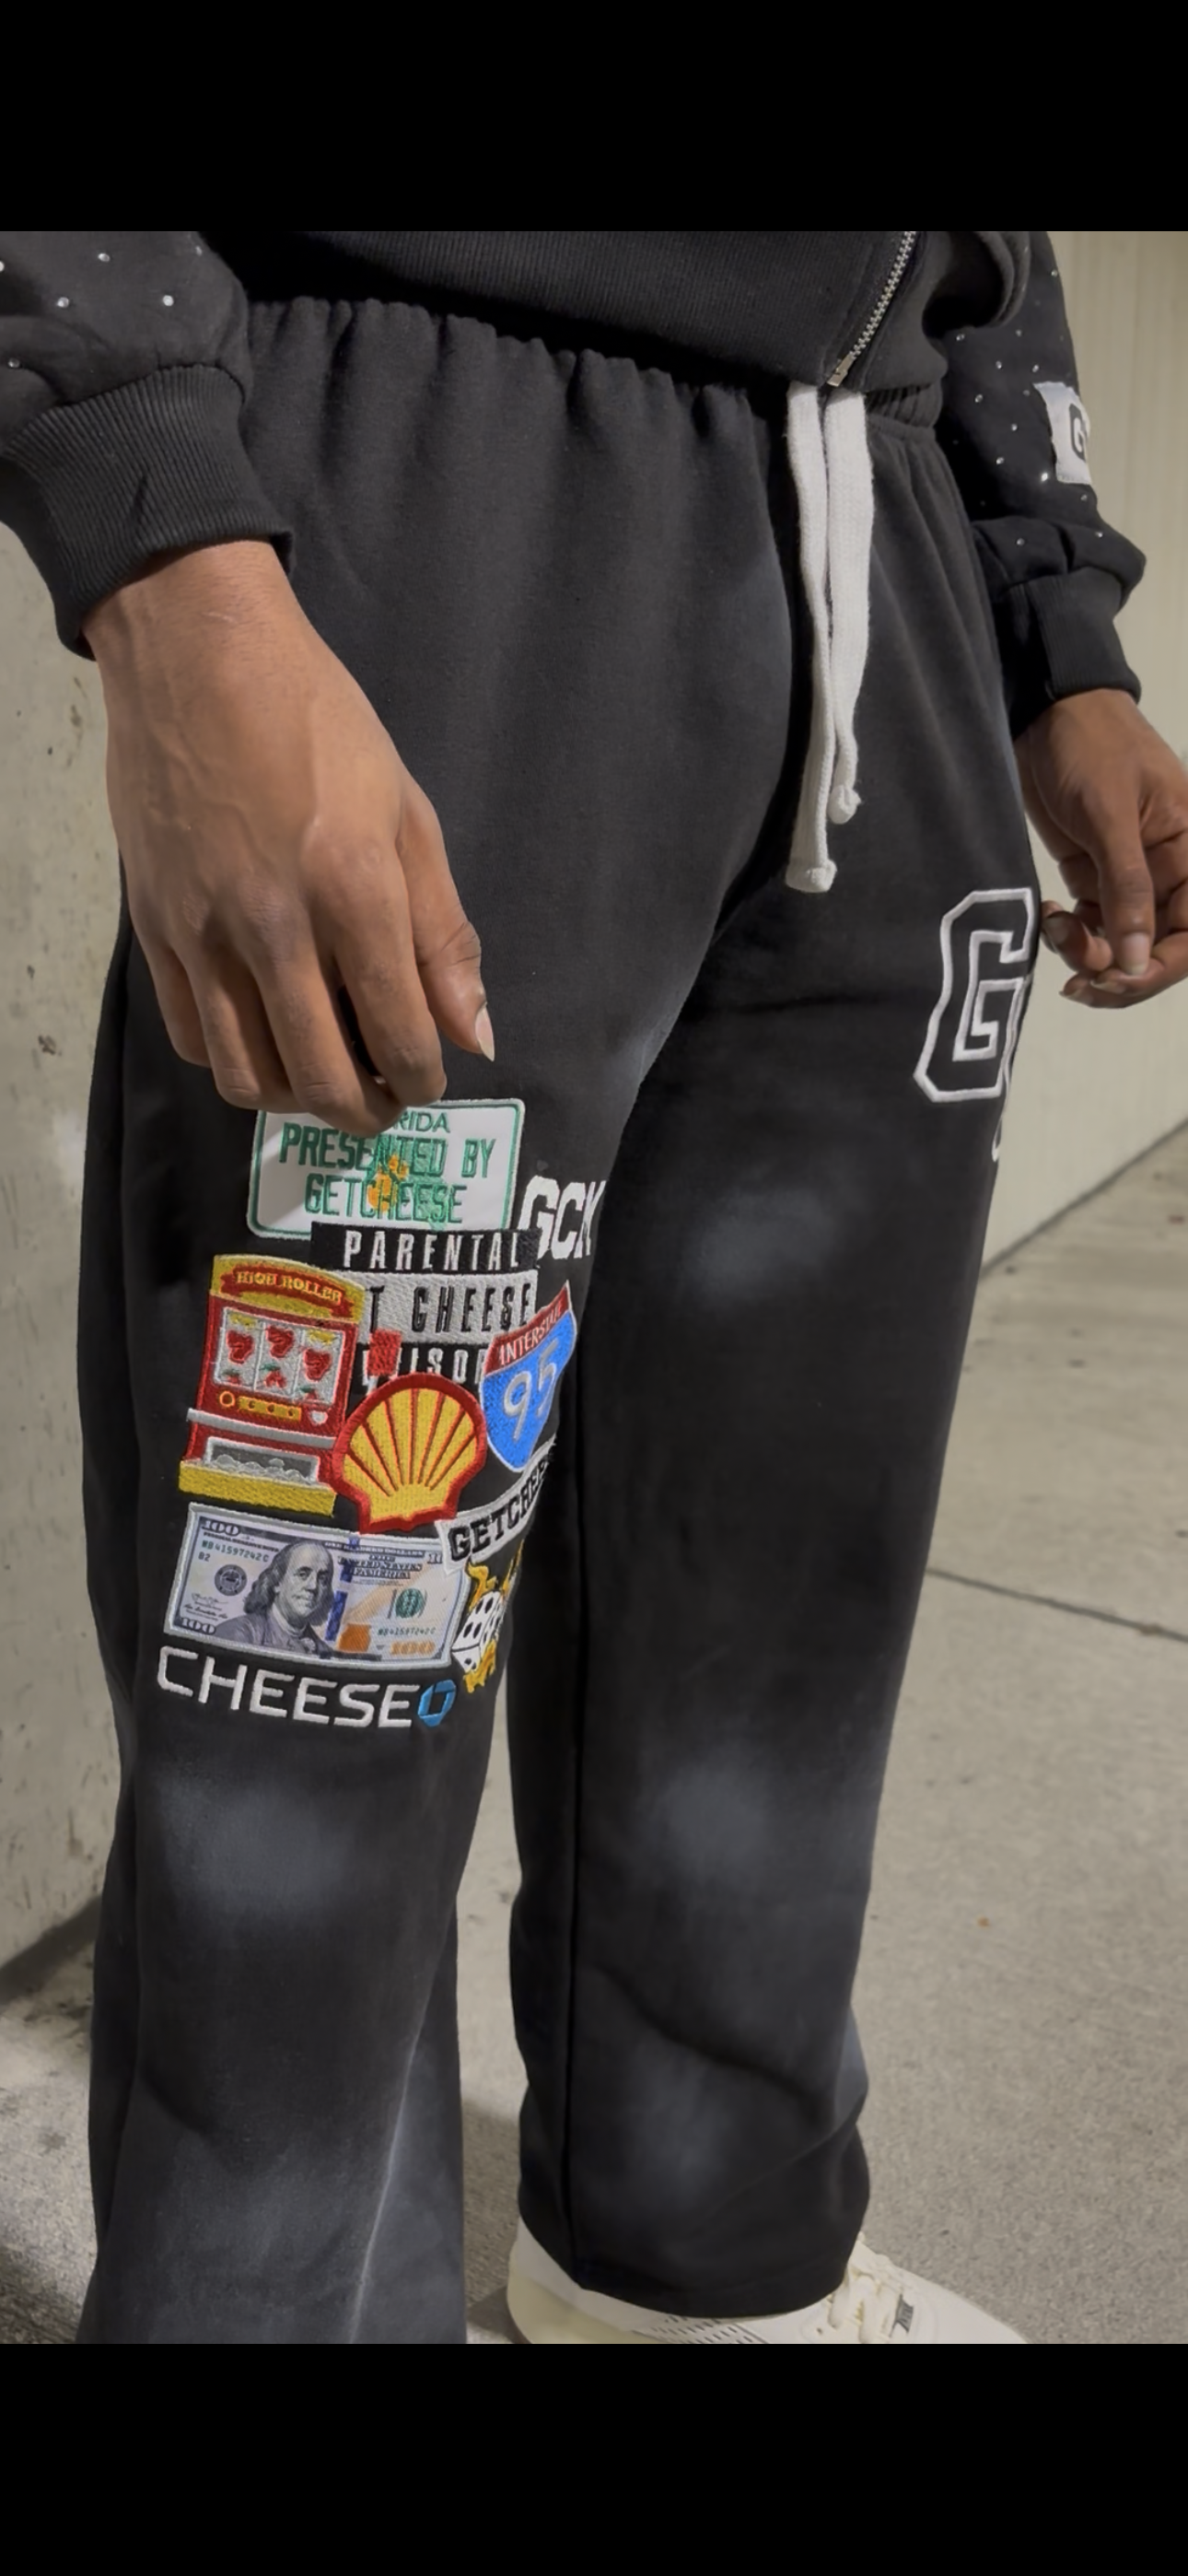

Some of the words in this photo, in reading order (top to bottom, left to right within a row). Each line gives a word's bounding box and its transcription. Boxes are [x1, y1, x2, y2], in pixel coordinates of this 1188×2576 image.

[393, 1109, 451, 1133] RIDA
[279, 1121, 448, 1177] PRESENTED
[461, 1138, 496, 1178] BY
[304, 1172, 468, 1224] GETCHEESE
[343, 1229, 519, 1271] PARENTAL
[235, 1270, 277, 1285] HIGH
[281, 1275, 343, 1306] ROLLER
[411, 1282, 532, 1334] CHEESE
[504, 1337, 558, 1442] 95
[201, 1518, 240, 1537] 100
[180, 1617, 216, 1635] 100
[157, 1645, 421, 1728] CHEESE
